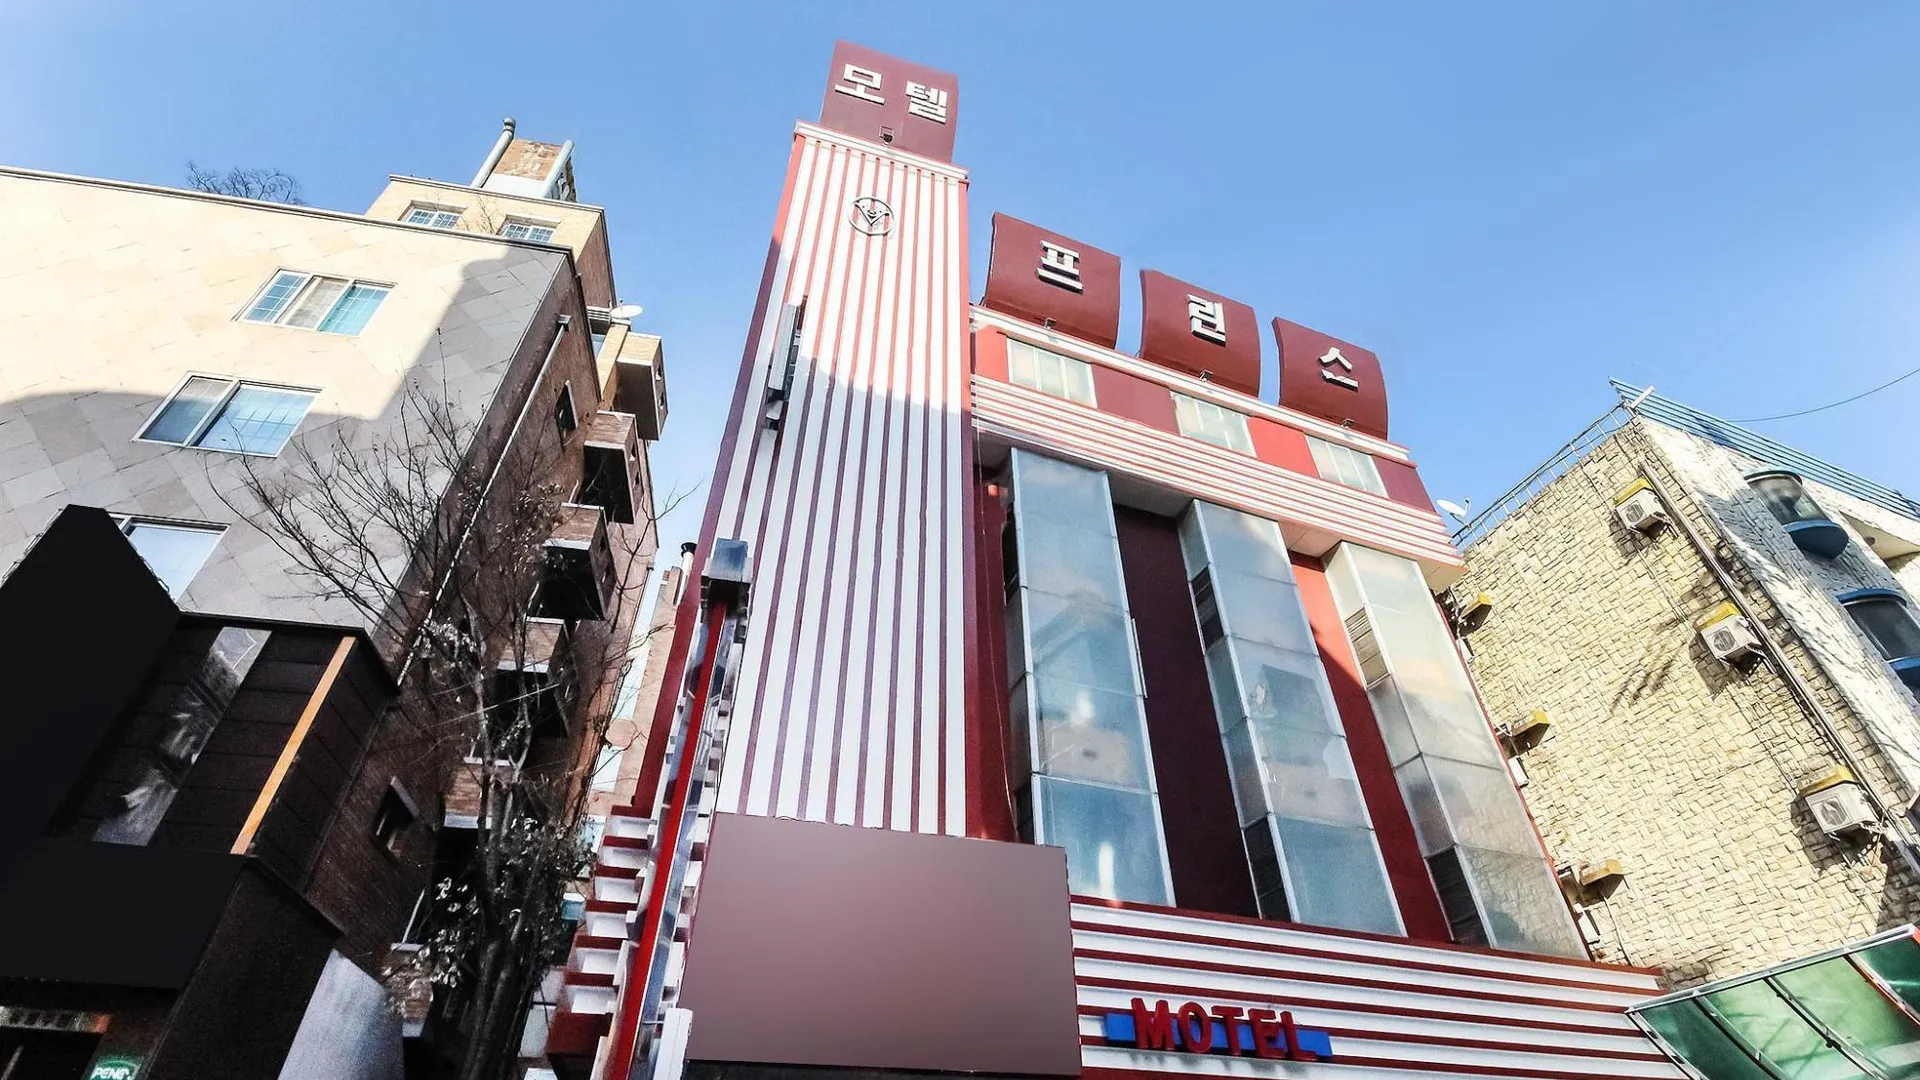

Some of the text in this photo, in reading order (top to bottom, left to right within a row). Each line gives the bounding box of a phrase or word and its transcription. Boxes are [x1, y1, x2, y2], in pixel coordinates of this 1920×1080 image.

[835, 63, 948, 125] 모텔
[1036, 239, 1359, 393] 프린스
[1131, 997, 1318, 1062] MOTEL
